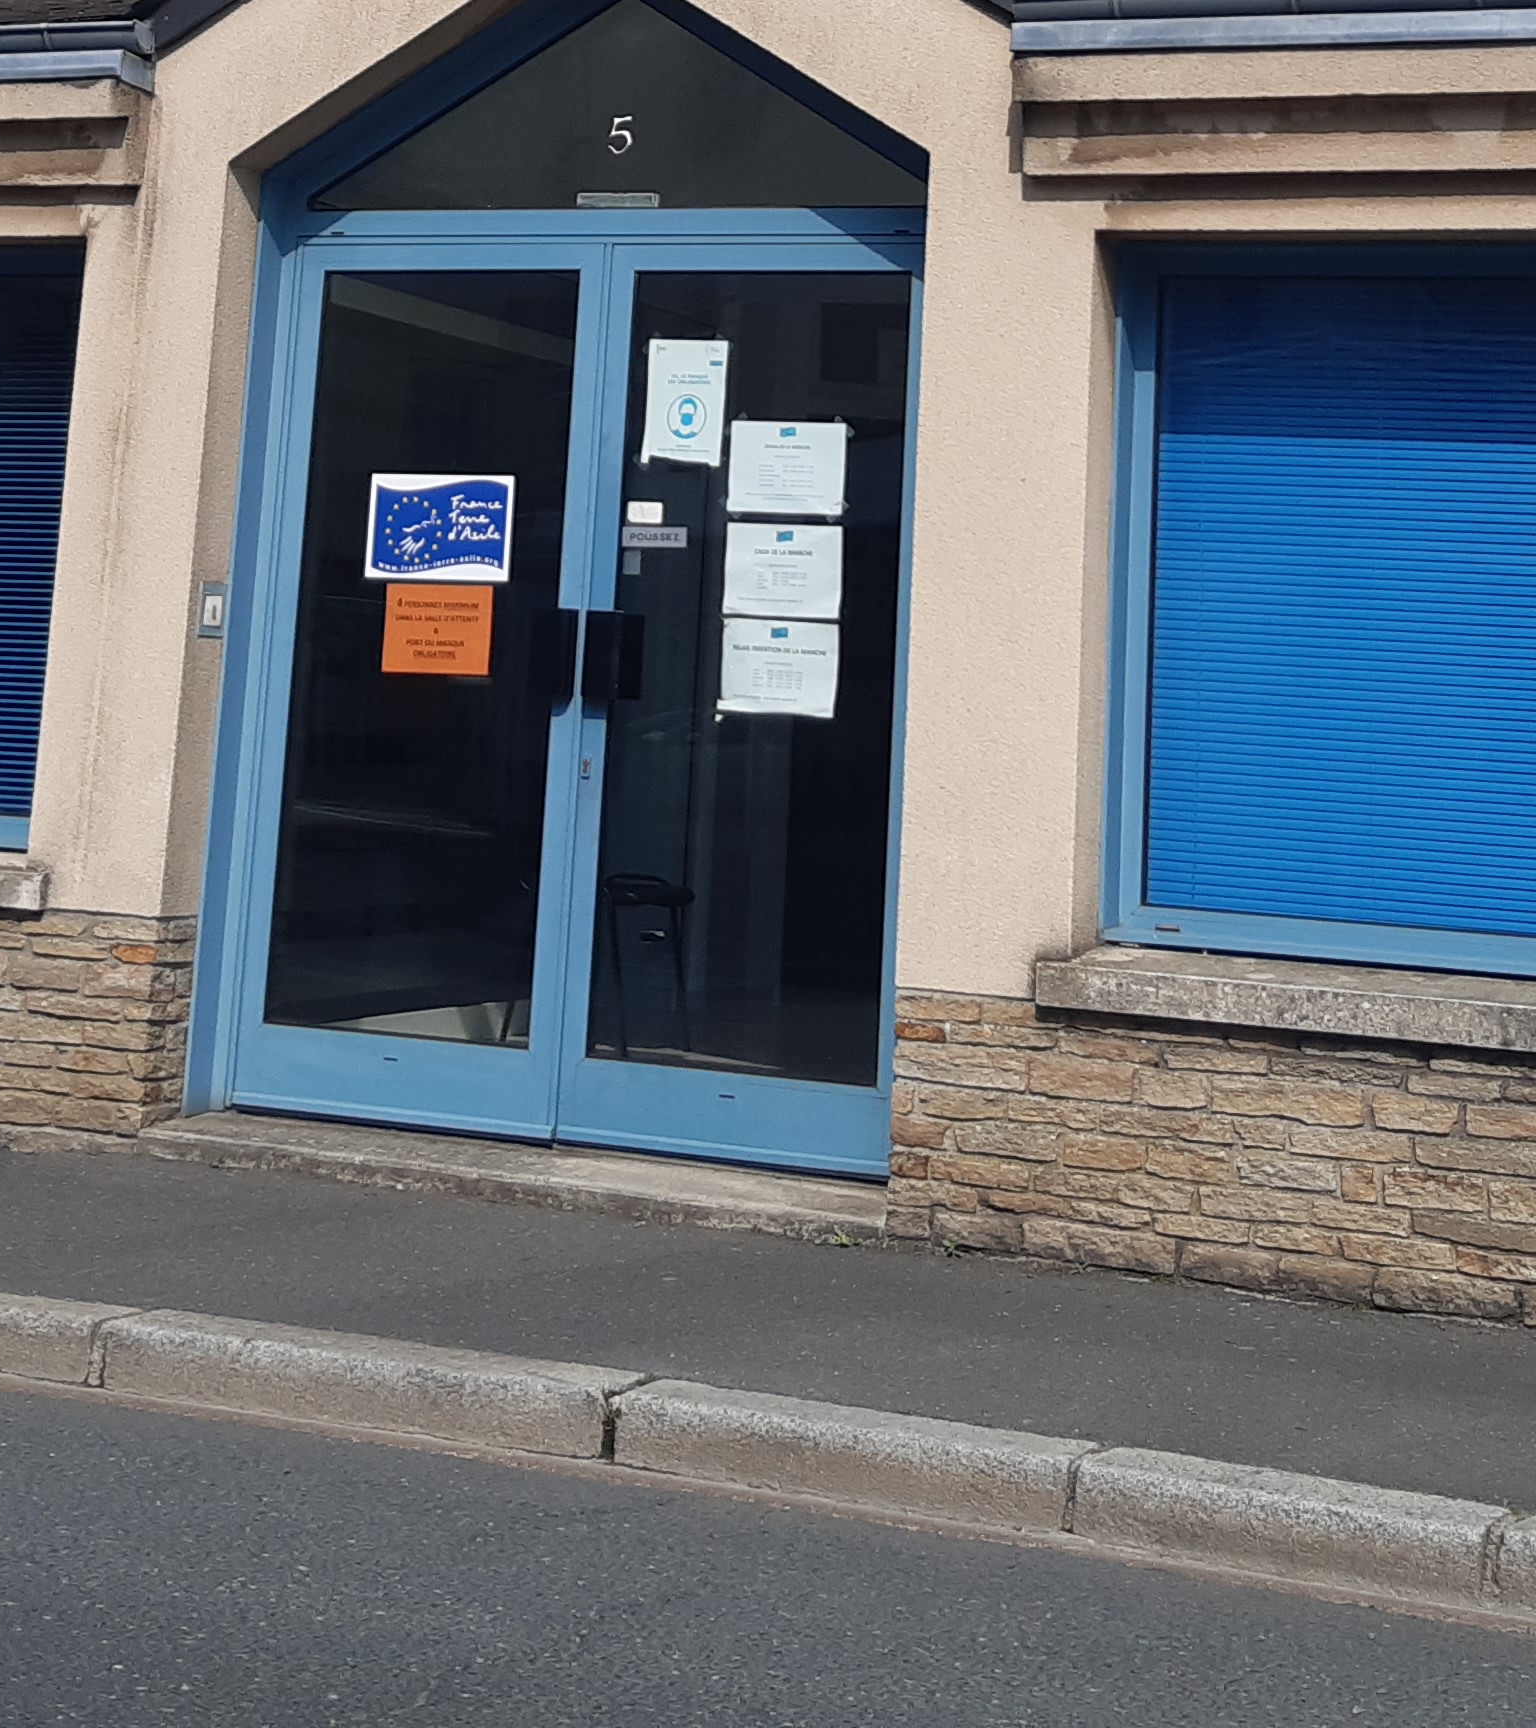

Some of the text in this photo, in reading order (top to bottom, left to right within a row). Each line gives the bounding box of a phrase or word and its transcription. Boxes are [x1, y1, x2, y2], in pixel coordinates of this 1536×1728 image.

[607, 115, 634, 155] 5
[450, 494, 503, 509] France
[629, 532, 679, 541] POUSSEZ
